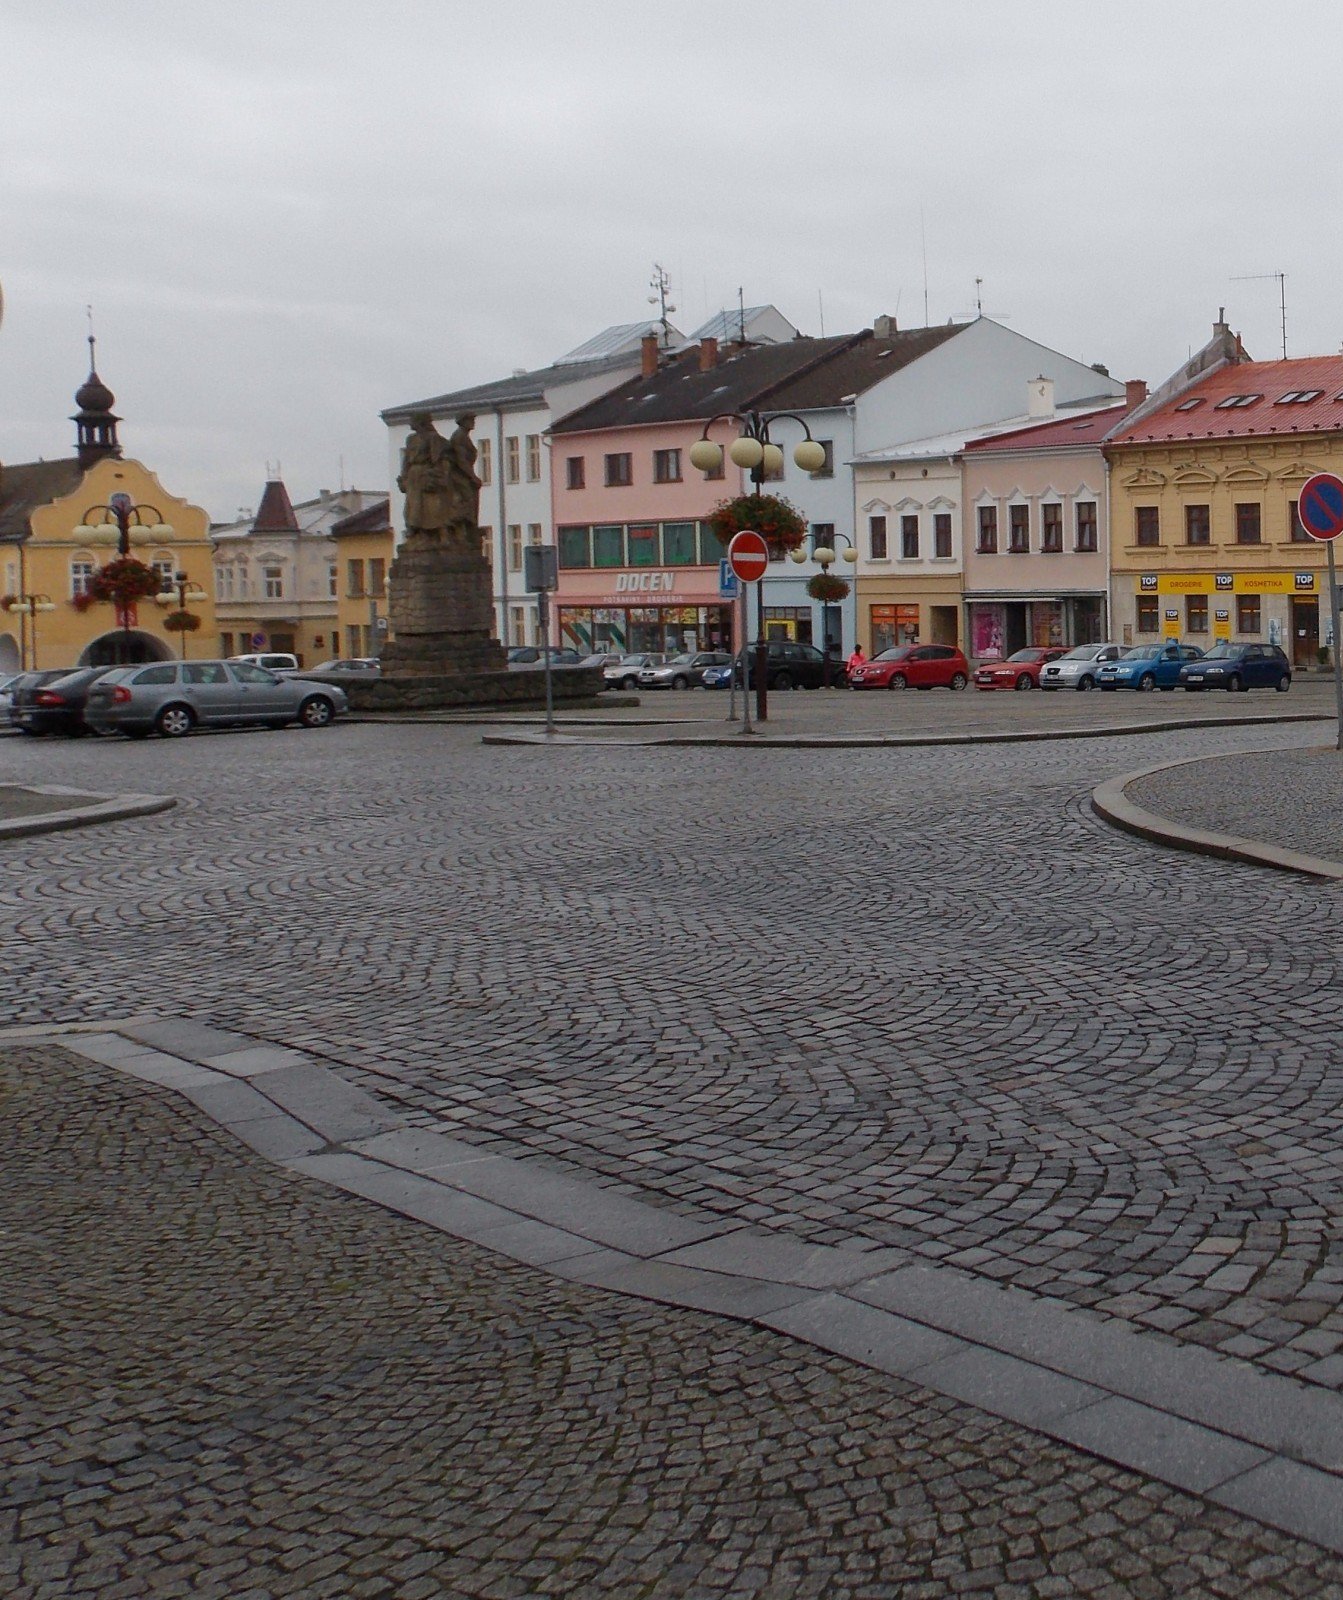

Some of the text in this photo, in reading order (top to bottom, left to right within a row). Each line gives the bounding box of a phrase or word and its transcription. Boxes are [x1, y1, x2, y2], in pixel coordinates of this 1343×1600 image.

[616, 572, 675, 592] DOCEN
[1141, 576, 1157, 585] TOP
[1216, 576, 1233, 585] TOP
[1244, 580, 1283, 588] KOSMETIKA
[1295, 575, 1313, 584] TOP
[1216, 610, 1228, 618] TOP
